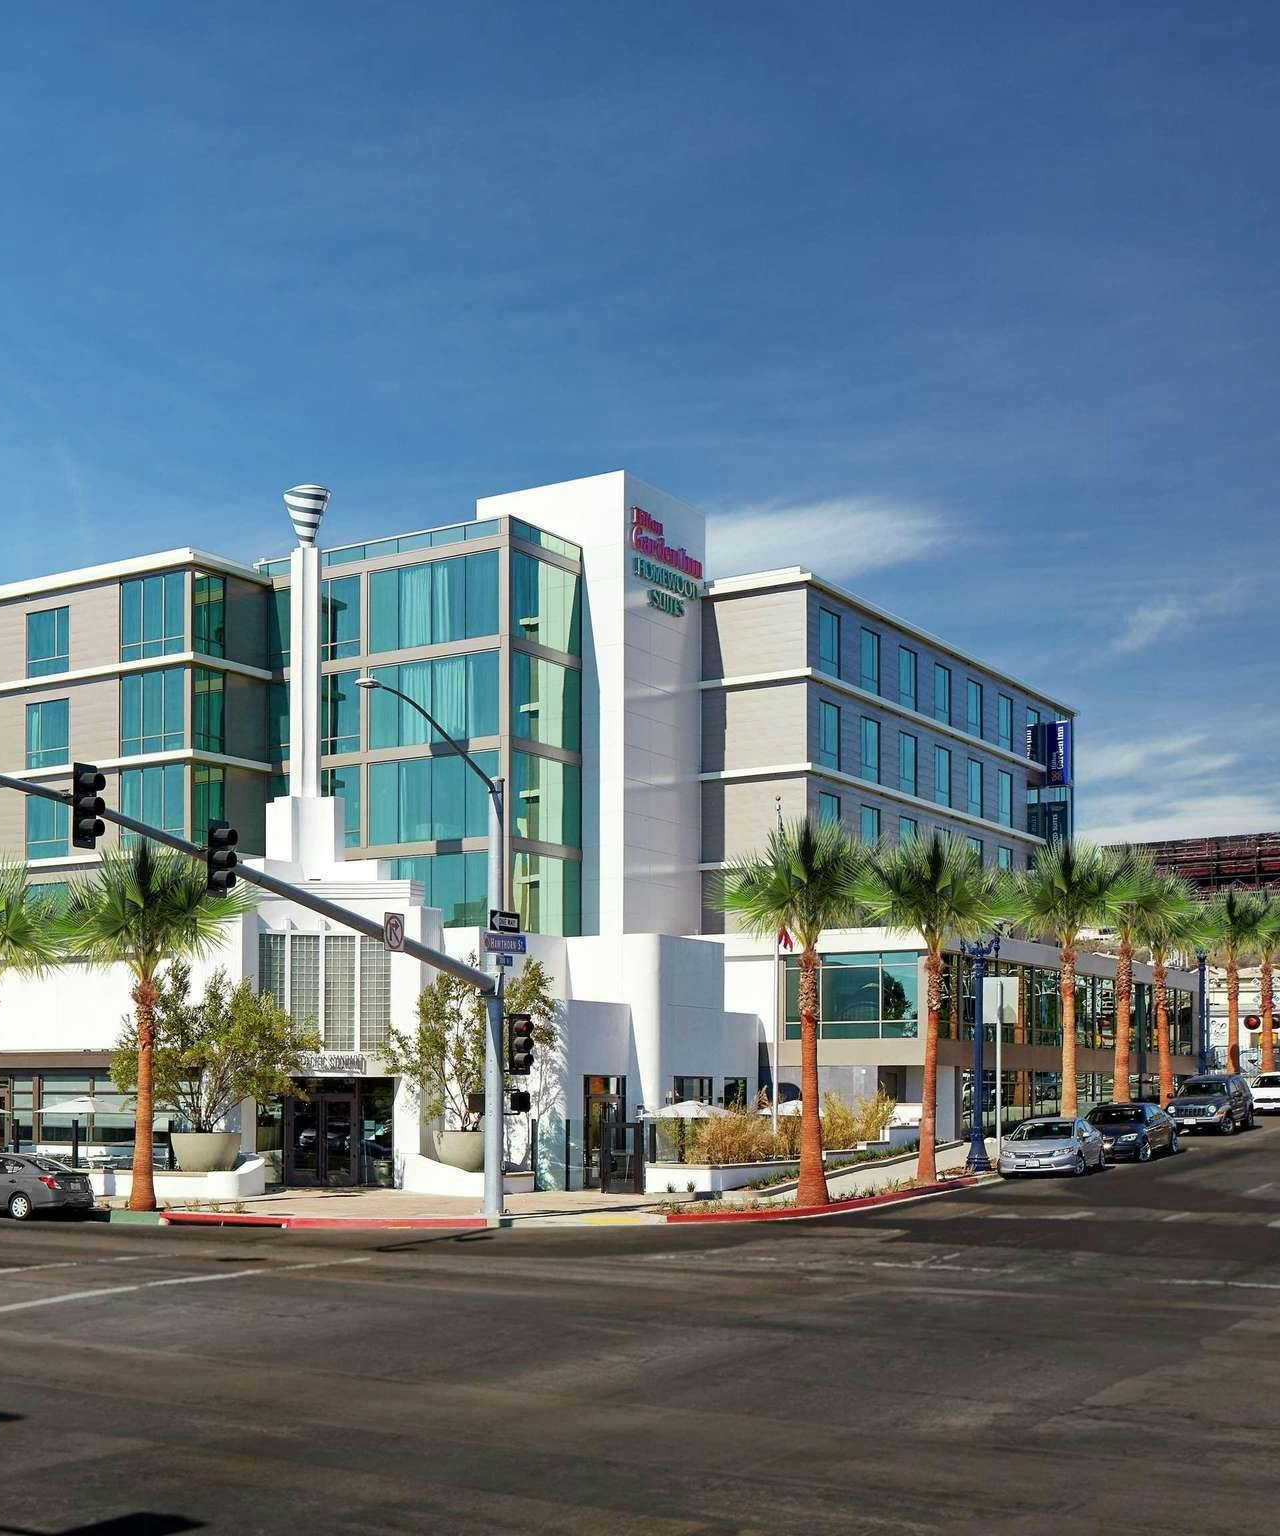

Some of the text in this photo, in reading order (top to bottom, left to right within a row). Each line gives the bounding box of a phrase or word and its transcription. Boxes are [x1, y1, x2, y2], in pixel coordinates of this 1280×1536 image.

[632, 525, 703, 579] Garden Inn
[634, 557, 699, 600] HOMEWOOD
[648, 589, 685, 617] SUITES
